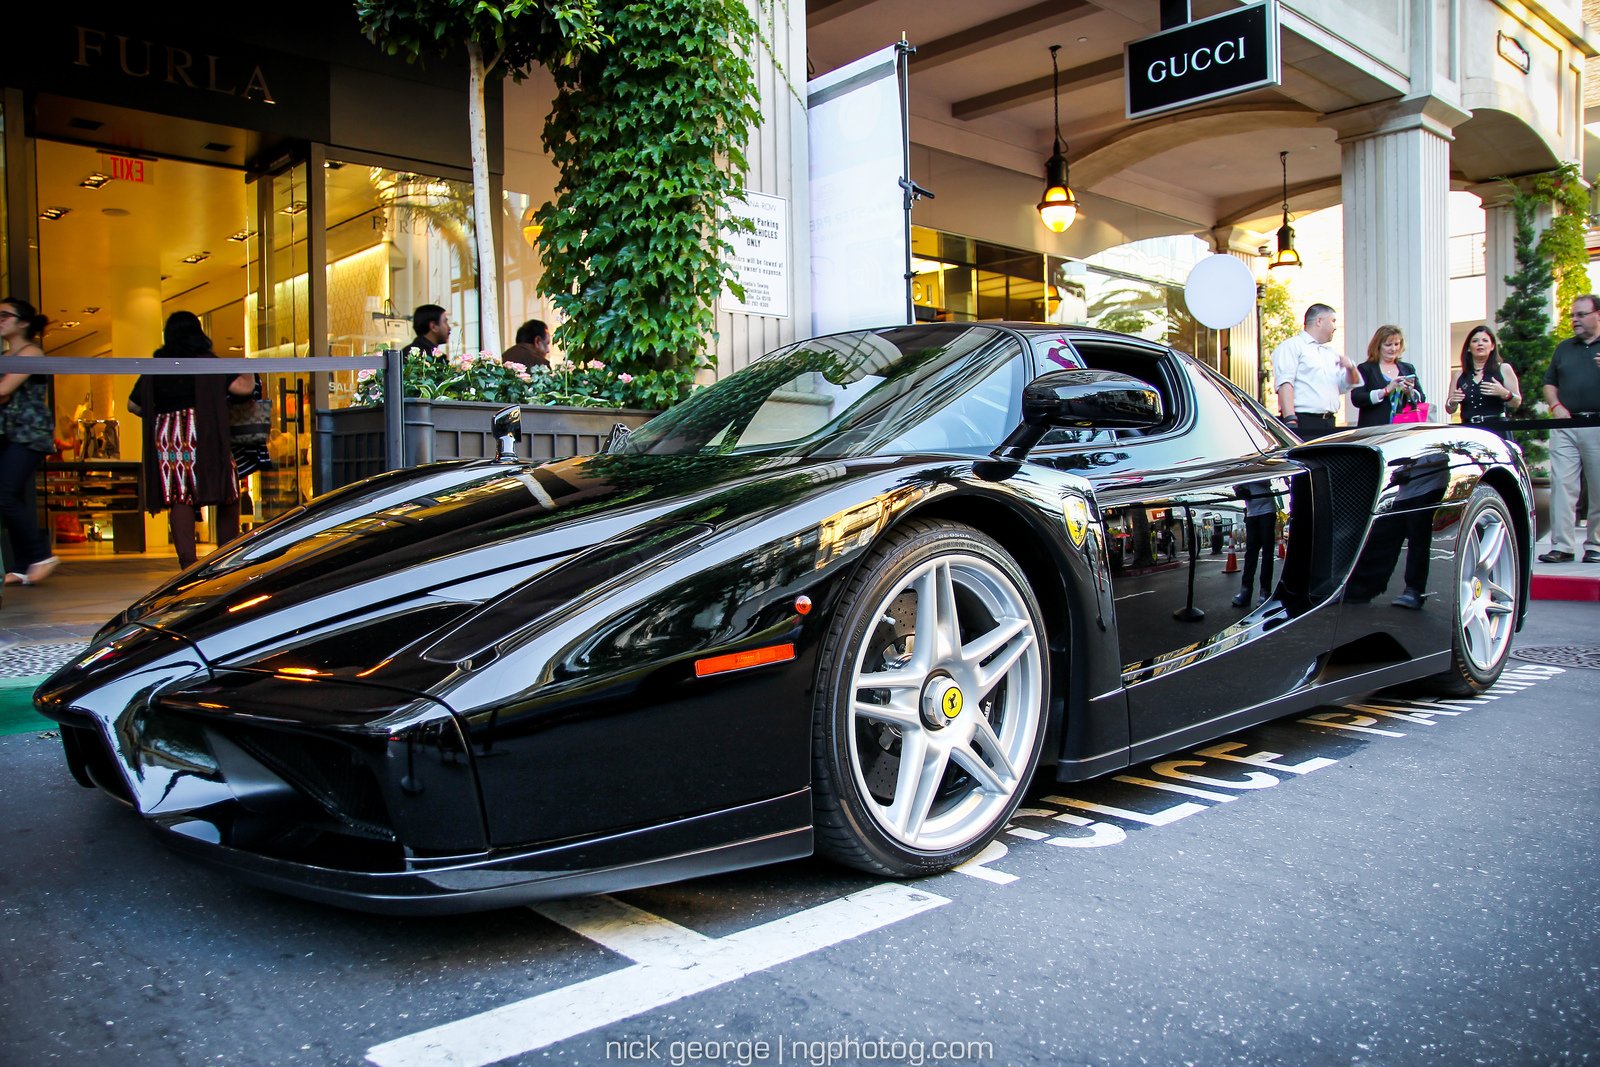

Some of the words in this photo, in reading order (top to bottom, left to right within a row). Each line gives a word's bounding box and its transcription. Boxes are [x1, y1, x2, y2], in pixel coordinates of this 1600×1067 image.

[72, 24, 276, 105] FURLA
[1146, 36, 1246, 84] GUCCI
[757, 217, 779, 230] Parking
[746, 237, 761, 248] ONLY
[328, 381, 354, 392] SALE
